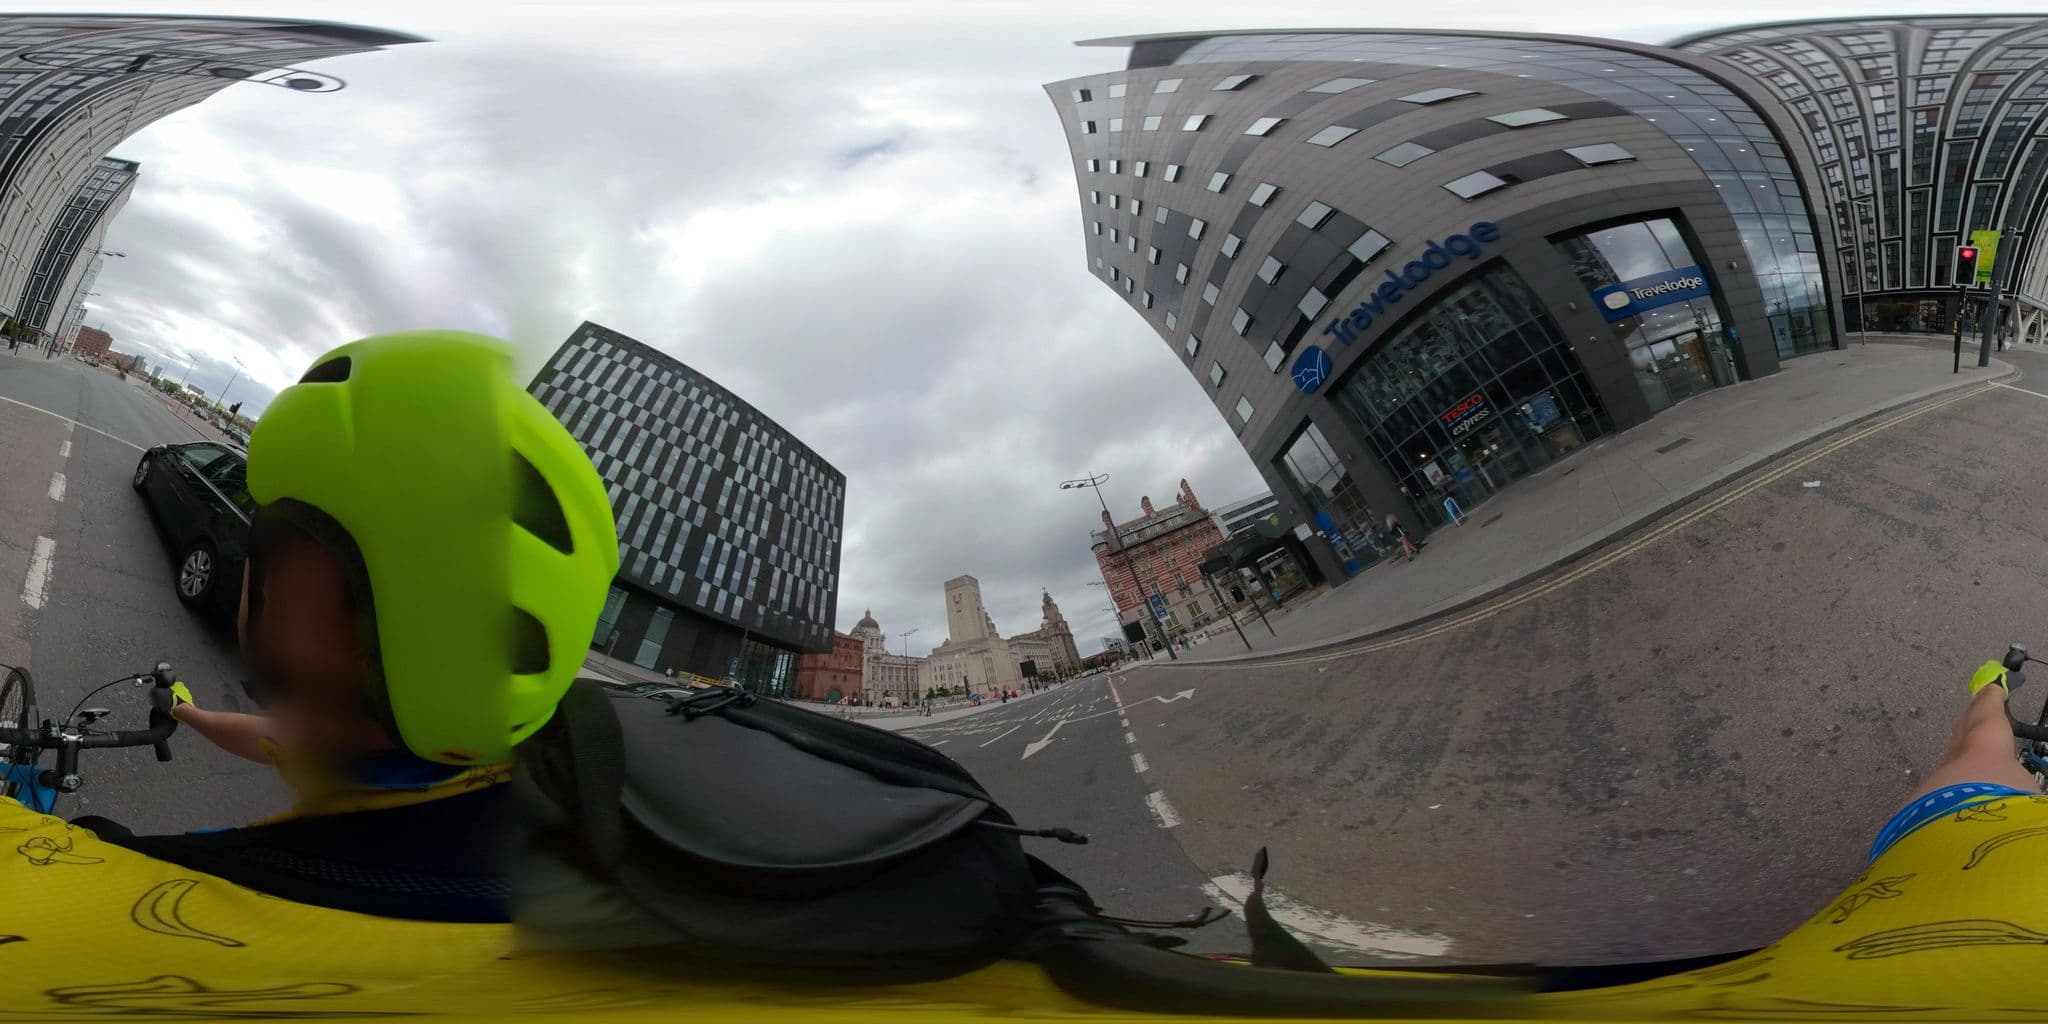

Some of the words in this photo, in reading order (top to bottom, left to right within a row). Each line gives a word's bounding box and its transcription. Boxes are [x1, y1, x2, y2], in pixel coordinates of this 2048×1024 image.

[1323, 221, 1500, 346] Travelodge
[1630, 276, 1703, 300] Travelodge
[1442, 393, 1484, 422] TESCO
[1452, 408, 1490, 435] express
